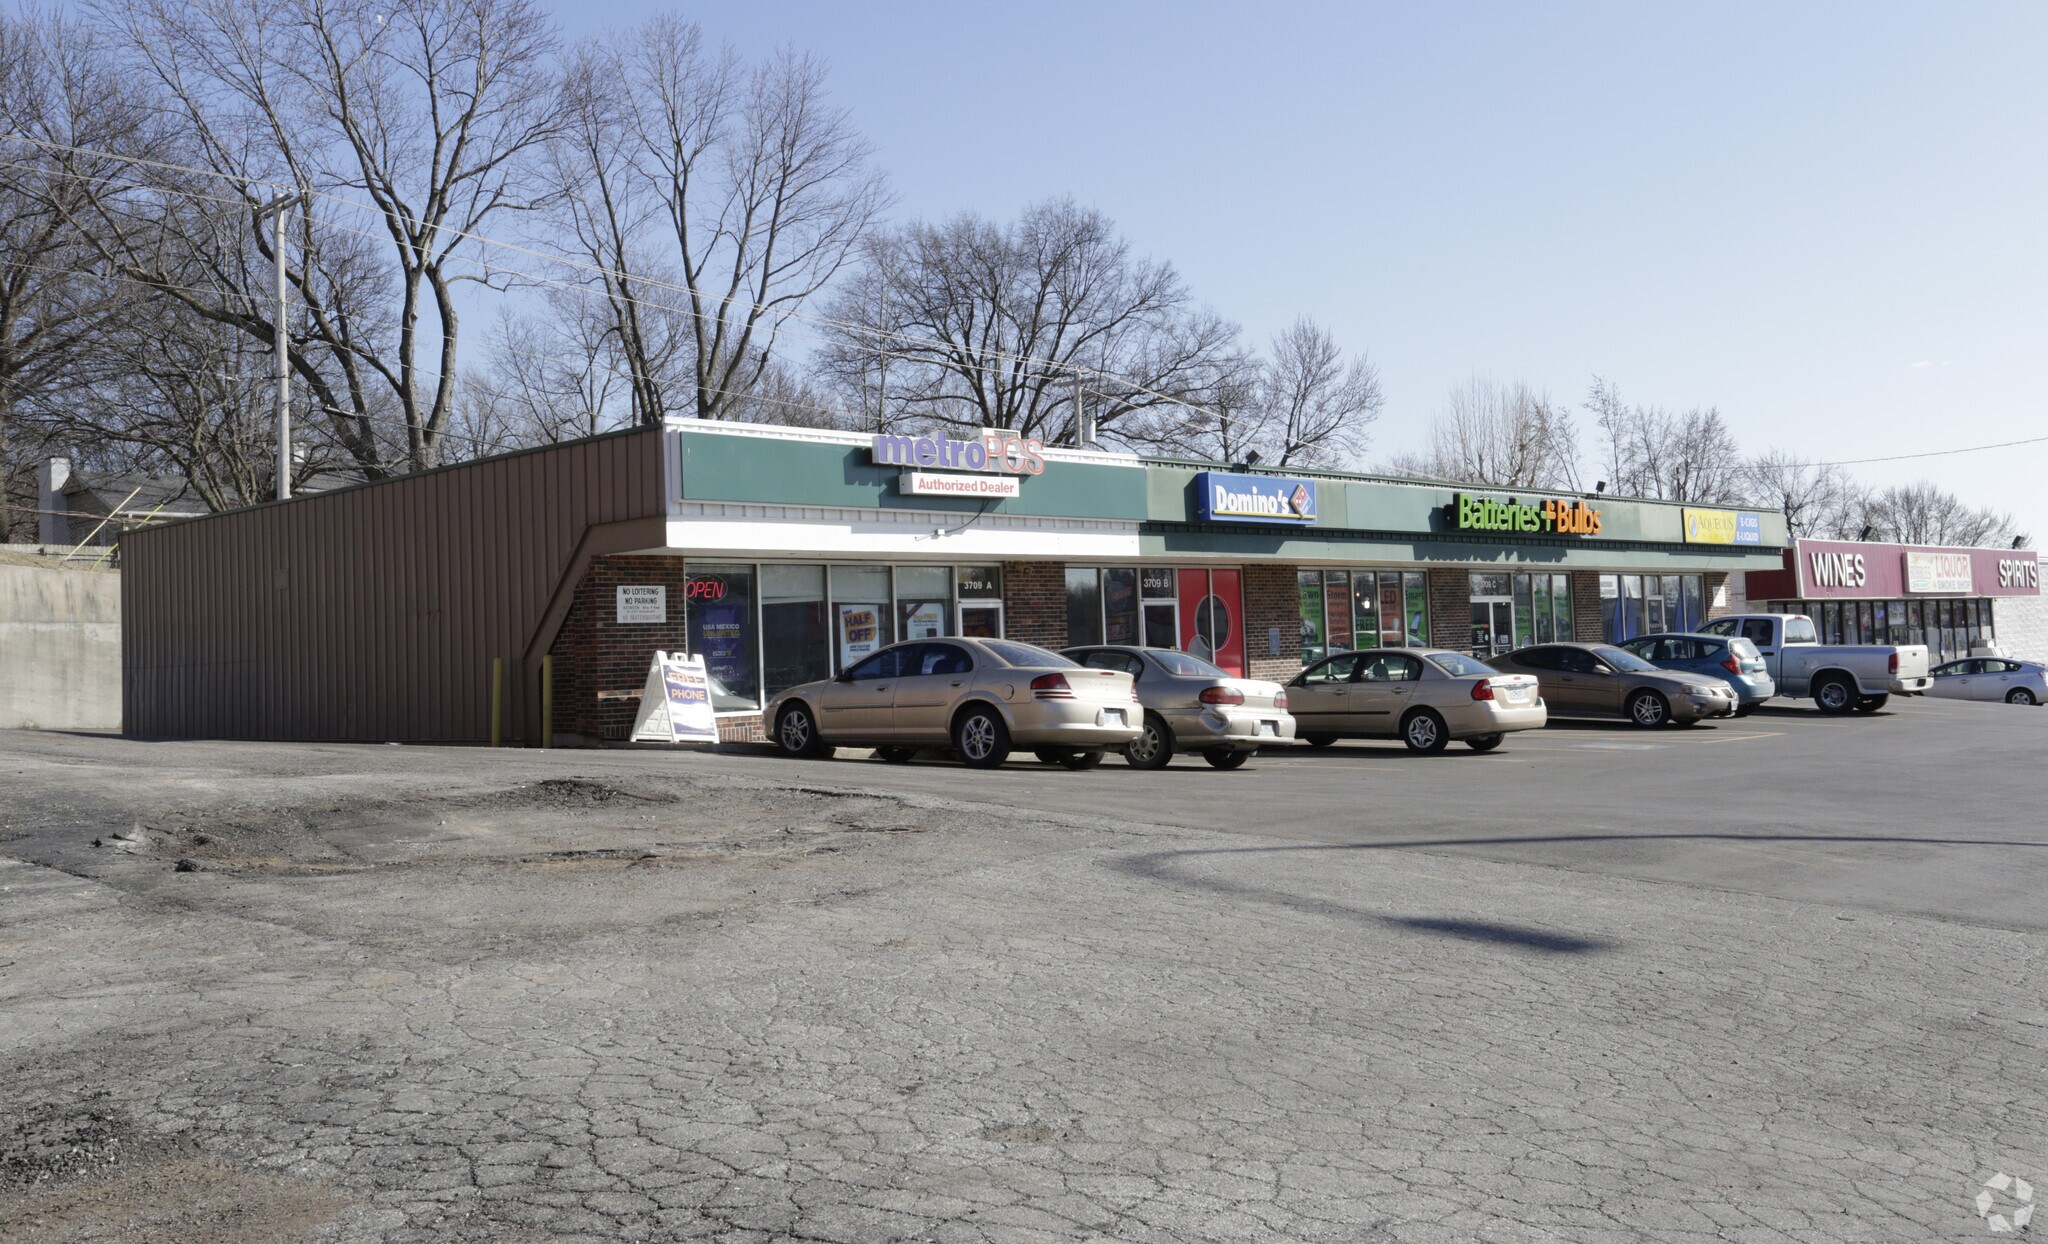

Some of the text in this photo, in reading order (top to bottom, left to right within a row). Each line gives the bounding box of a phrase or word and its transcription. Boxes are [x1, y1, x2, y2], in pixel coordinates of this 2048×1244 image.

[878, 431, 1046, 475] metroPCS
[918, 478, 1014, 493] Authorized Dealer
[1215, 485, 1290, 514] Domino's
[1459, 493, 1540, 532] Batteries
[1699, 514, 1734, 531] AQUEOUS
[1741, 517, 1757, 528] E-CIGS
[1737, 531, 1758, 541] E-LIQUID
[1811, 552, 1866, 587] WINES
[1935, 556, 1970, 578] LIQUOR
[1999, 559, 2037, 587] SPIRITS
[686, 582, 724, 598] OPEN
[1144, 579, 1169, 588] 3709 B
[1938, 580, 1956, 590] SMOKE
[1957, 580, 1970, 589] SHOP
[1380, 590, 1397, 604] LED
[1405, 590, 1424, 600] Smart
[845, 613, 870, 627] HALF
[1356, 619, 1375, 630] FREE
[849, 628, 871, 643] OFF
[668, 672, 703, 684] FREE
[671, 689, 705, 700] PHONE
